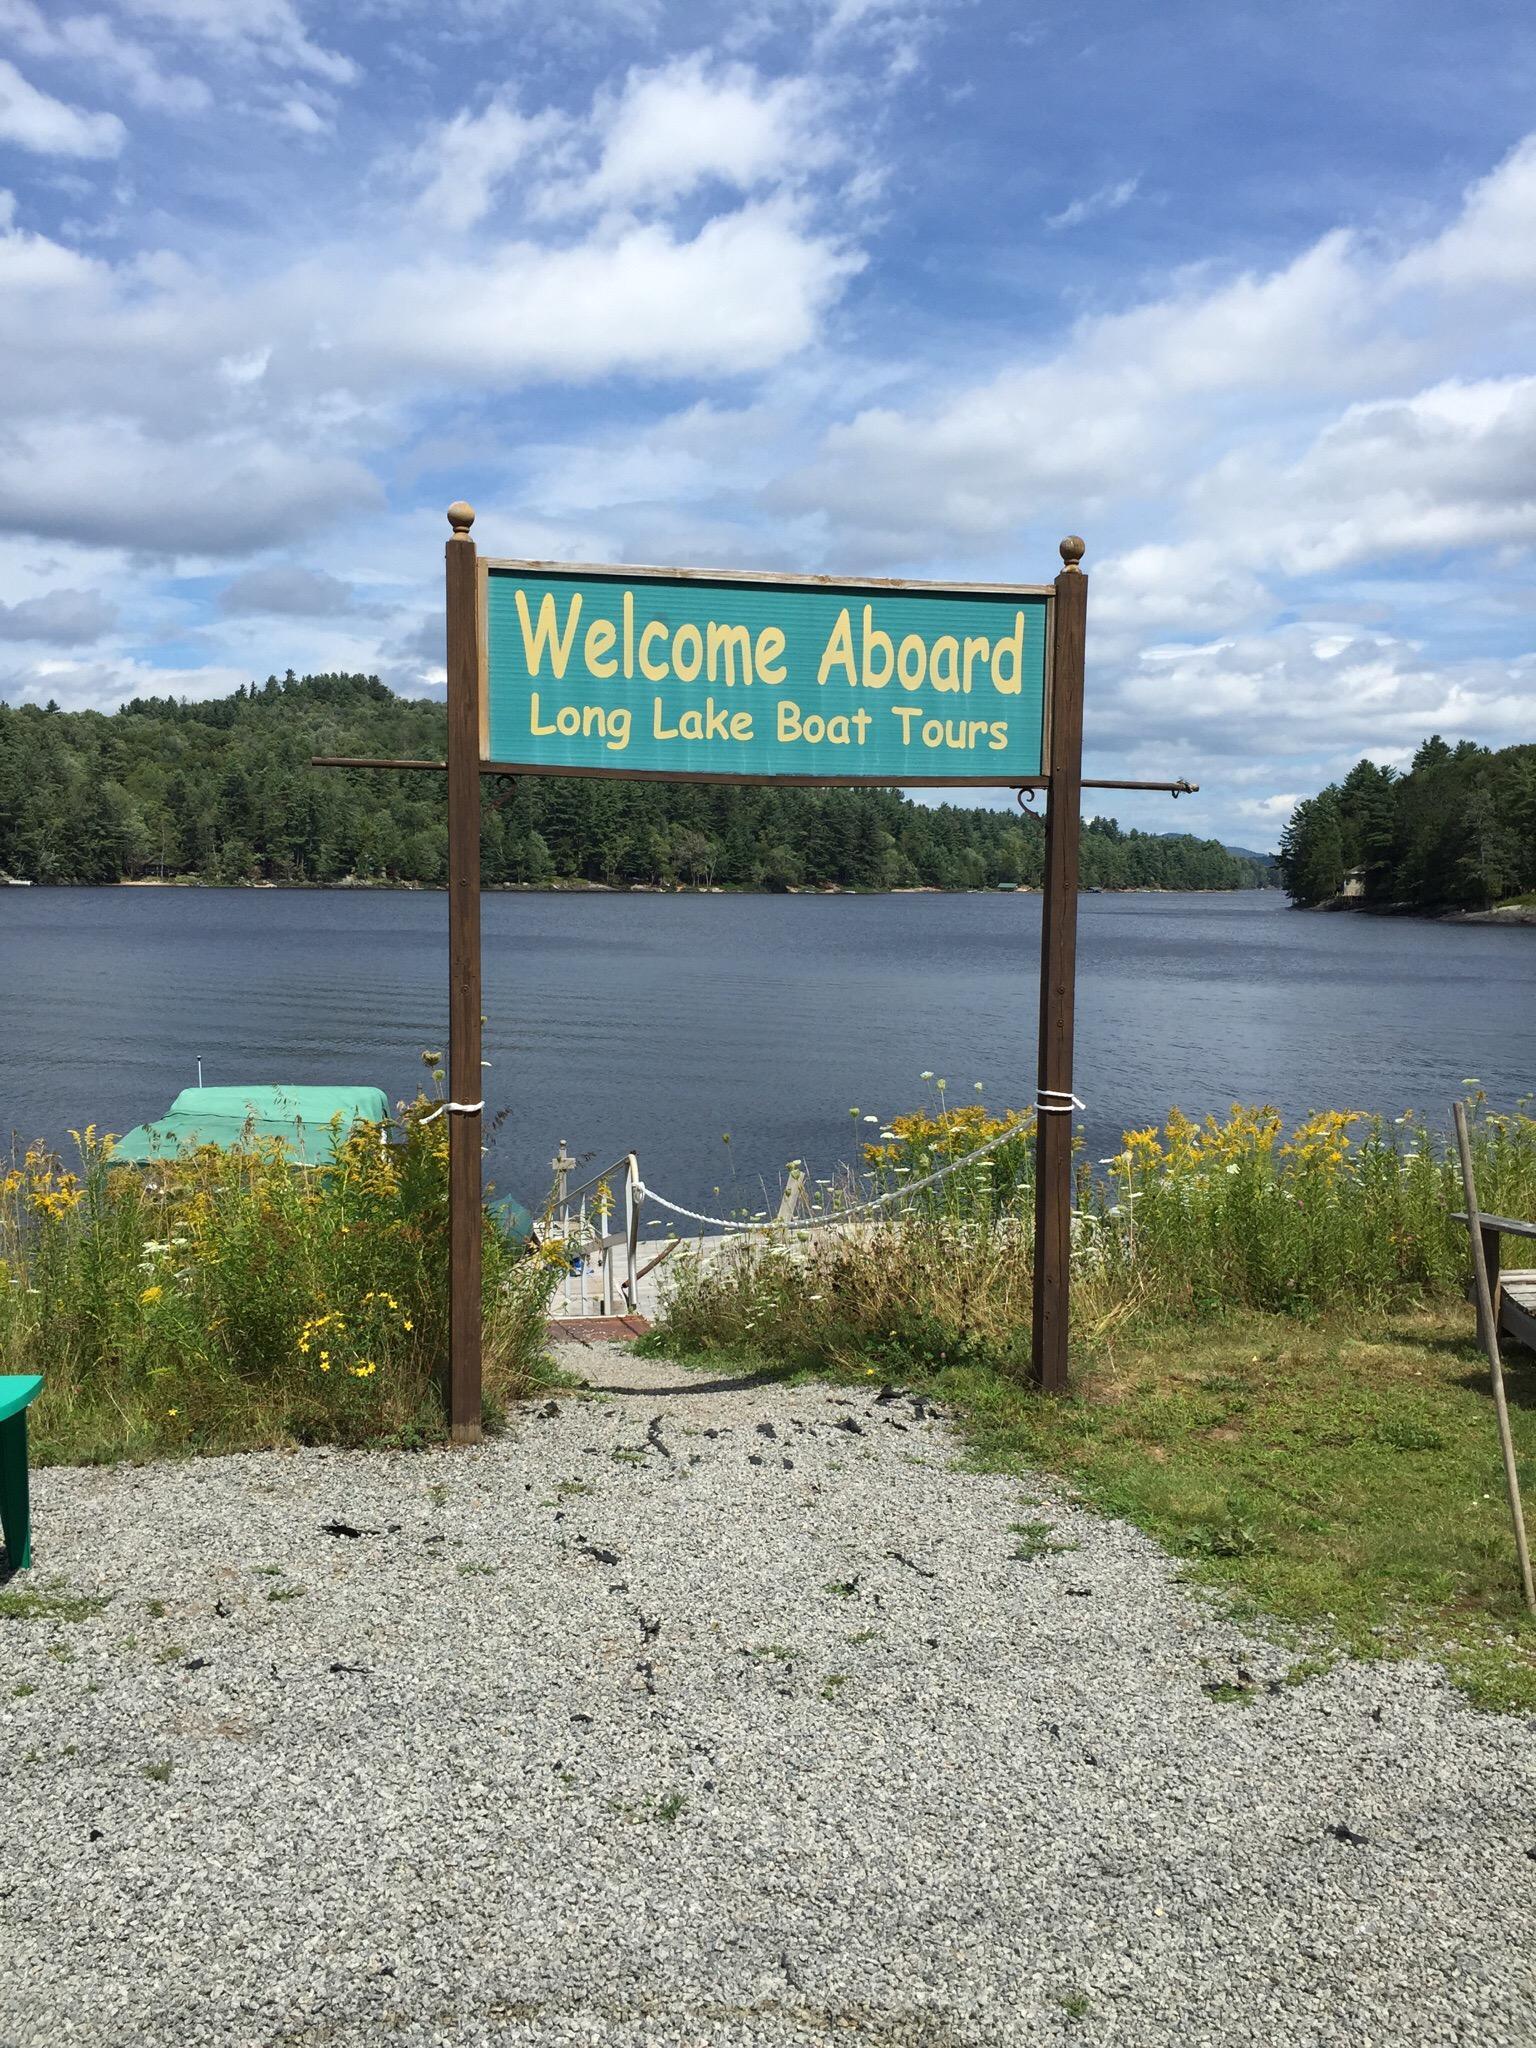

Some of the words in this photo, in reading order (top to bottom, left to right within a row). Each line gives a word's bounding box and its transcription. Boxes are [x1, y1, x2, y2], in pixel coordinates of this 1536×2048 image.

[514, 589, 787, 687] Welcome
[817, 604, 1025, 695] Aboard
[530, 692, 632, 750] Long
[653, 696, 754, 741] Lake
[777, 700, 873, 745] Boat
[891, 706, 1009, 750] Tours
